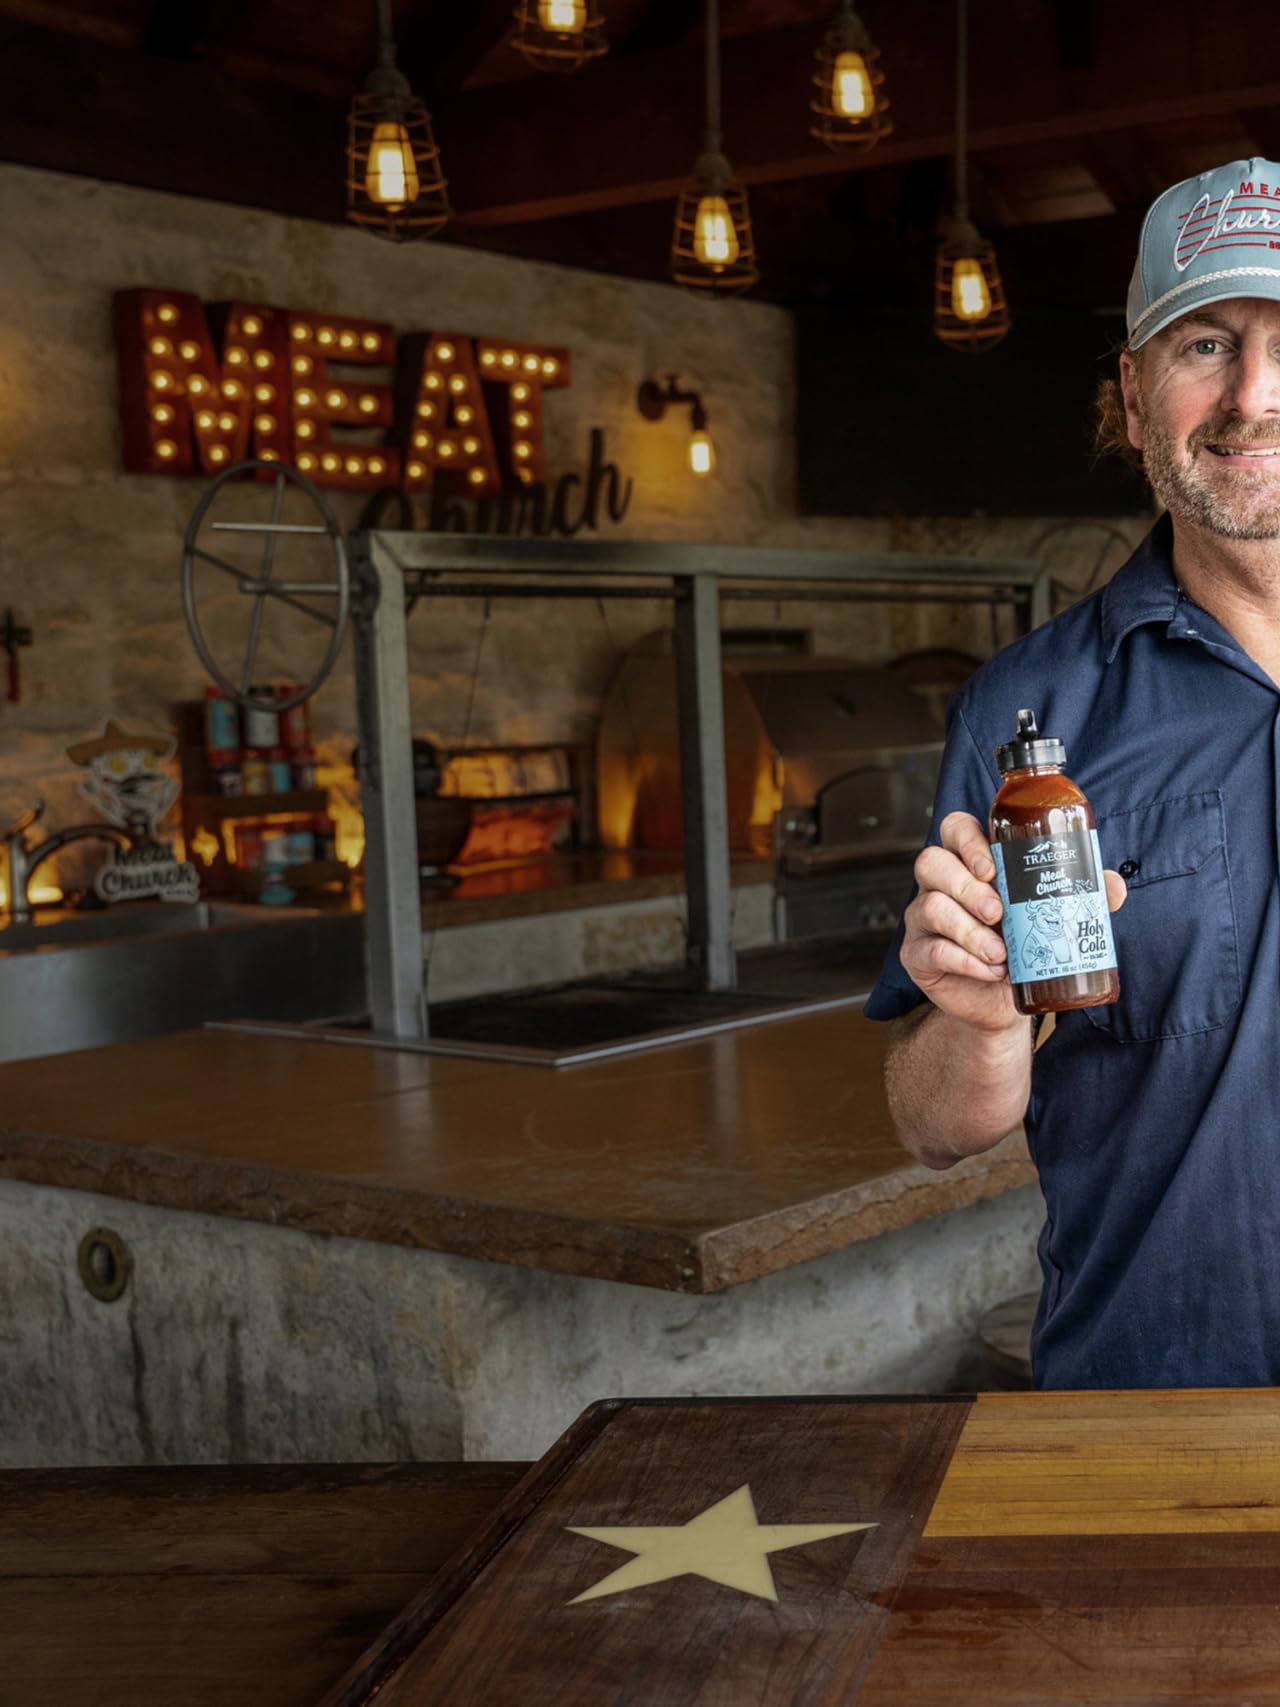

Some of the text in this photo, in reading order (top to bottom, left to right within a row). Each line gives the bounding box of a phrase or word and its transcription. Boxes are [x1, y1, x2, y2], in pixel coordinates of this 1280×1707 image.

[115, 288, 571, 498] MEAT
[1023, 849, 1077, 866] TRAEGER
[102, 865, 192, 895] Church
[1040, 867, 1067, 884] Meat
[1036, 877, 1073, 896] Church
[1077, 918, 1104, 940] Holy
[1079, 936, 1107, 954] Cola
[1036, 968, 1048, 977] NET
